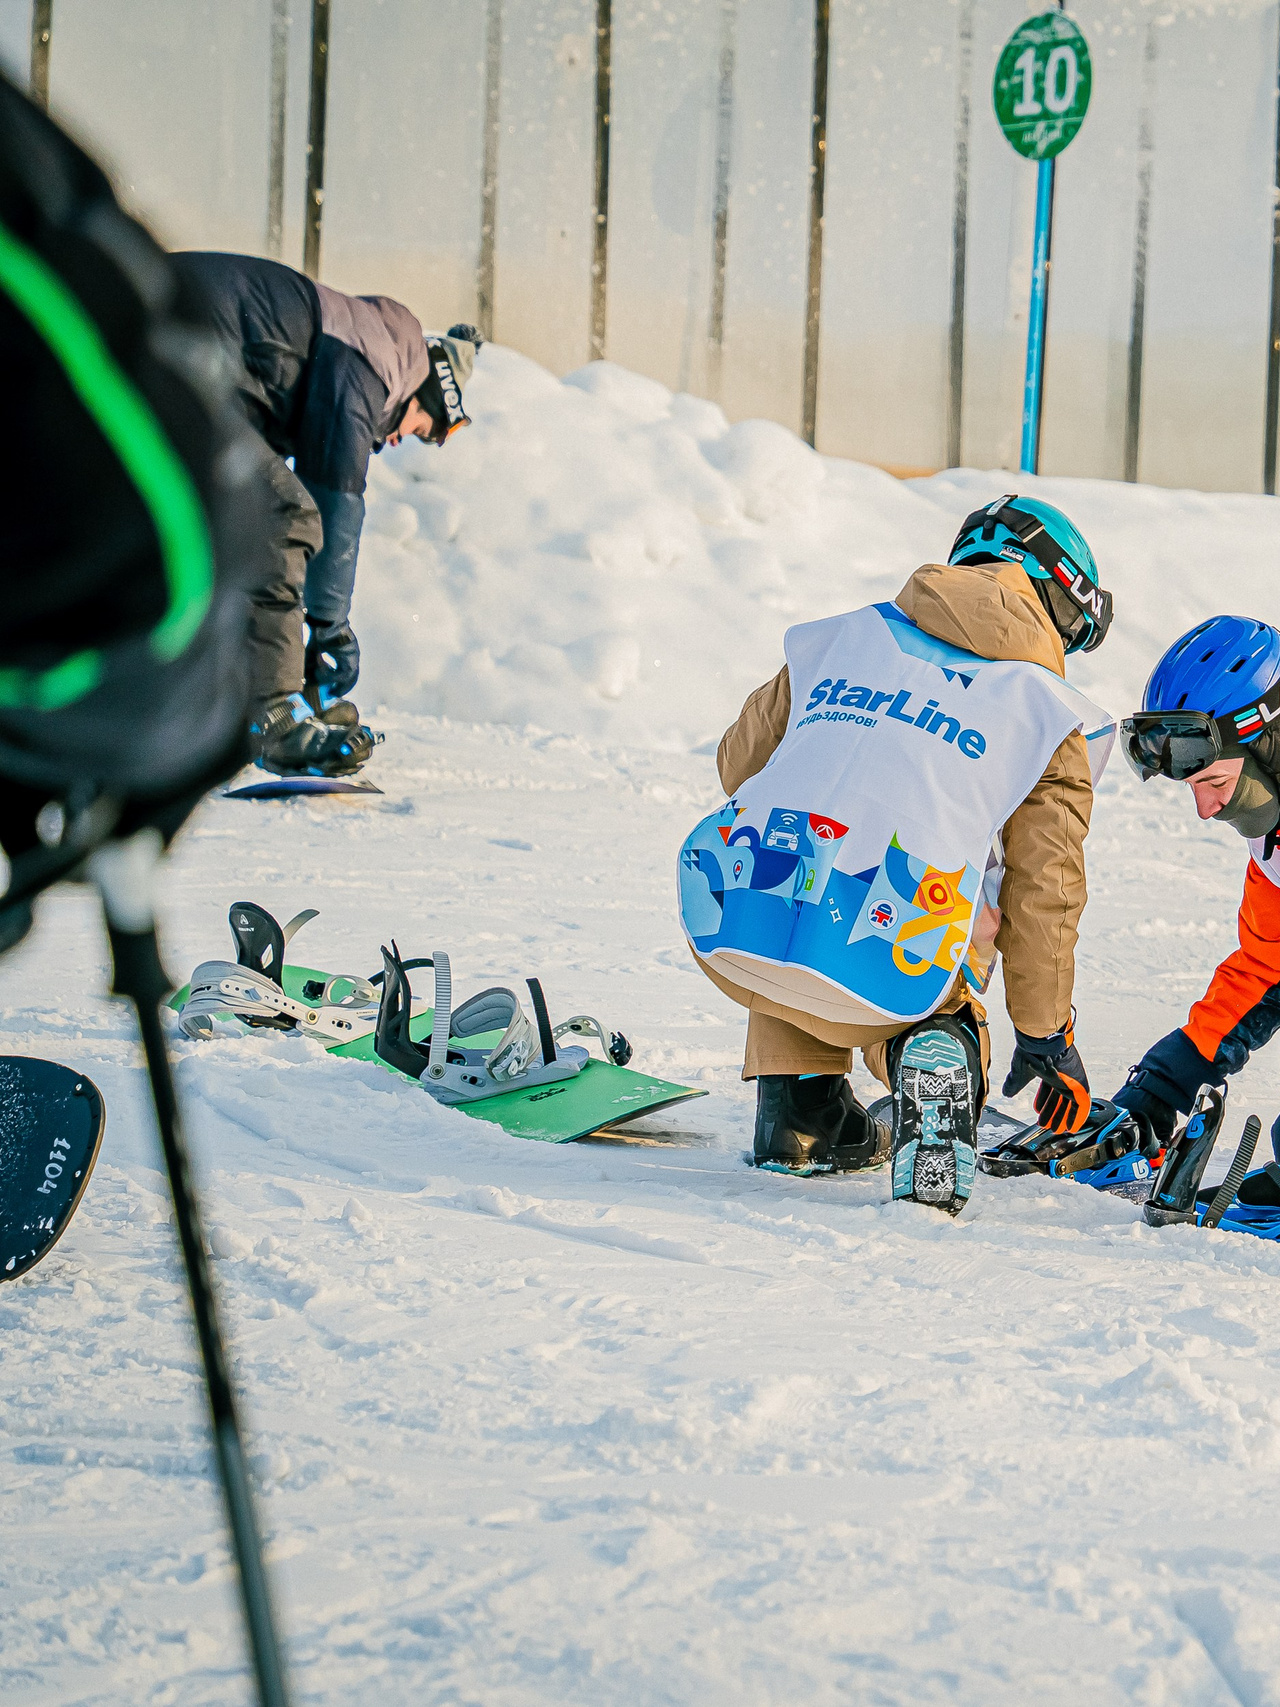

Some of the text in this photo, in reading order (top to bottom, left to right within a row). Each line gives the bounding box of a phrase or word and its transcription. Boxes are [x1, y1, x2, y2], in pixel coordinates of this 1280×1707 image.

[1013, 45, 1078, 117] 10
[435, 361, 464, 425] uvex
[1053, 556, 1104, 619] ELAX
[805, 678, 987, 760] StarLine
[920, 1099, 948, 1146] head
[36, 1137, 71, 1195] 1104
